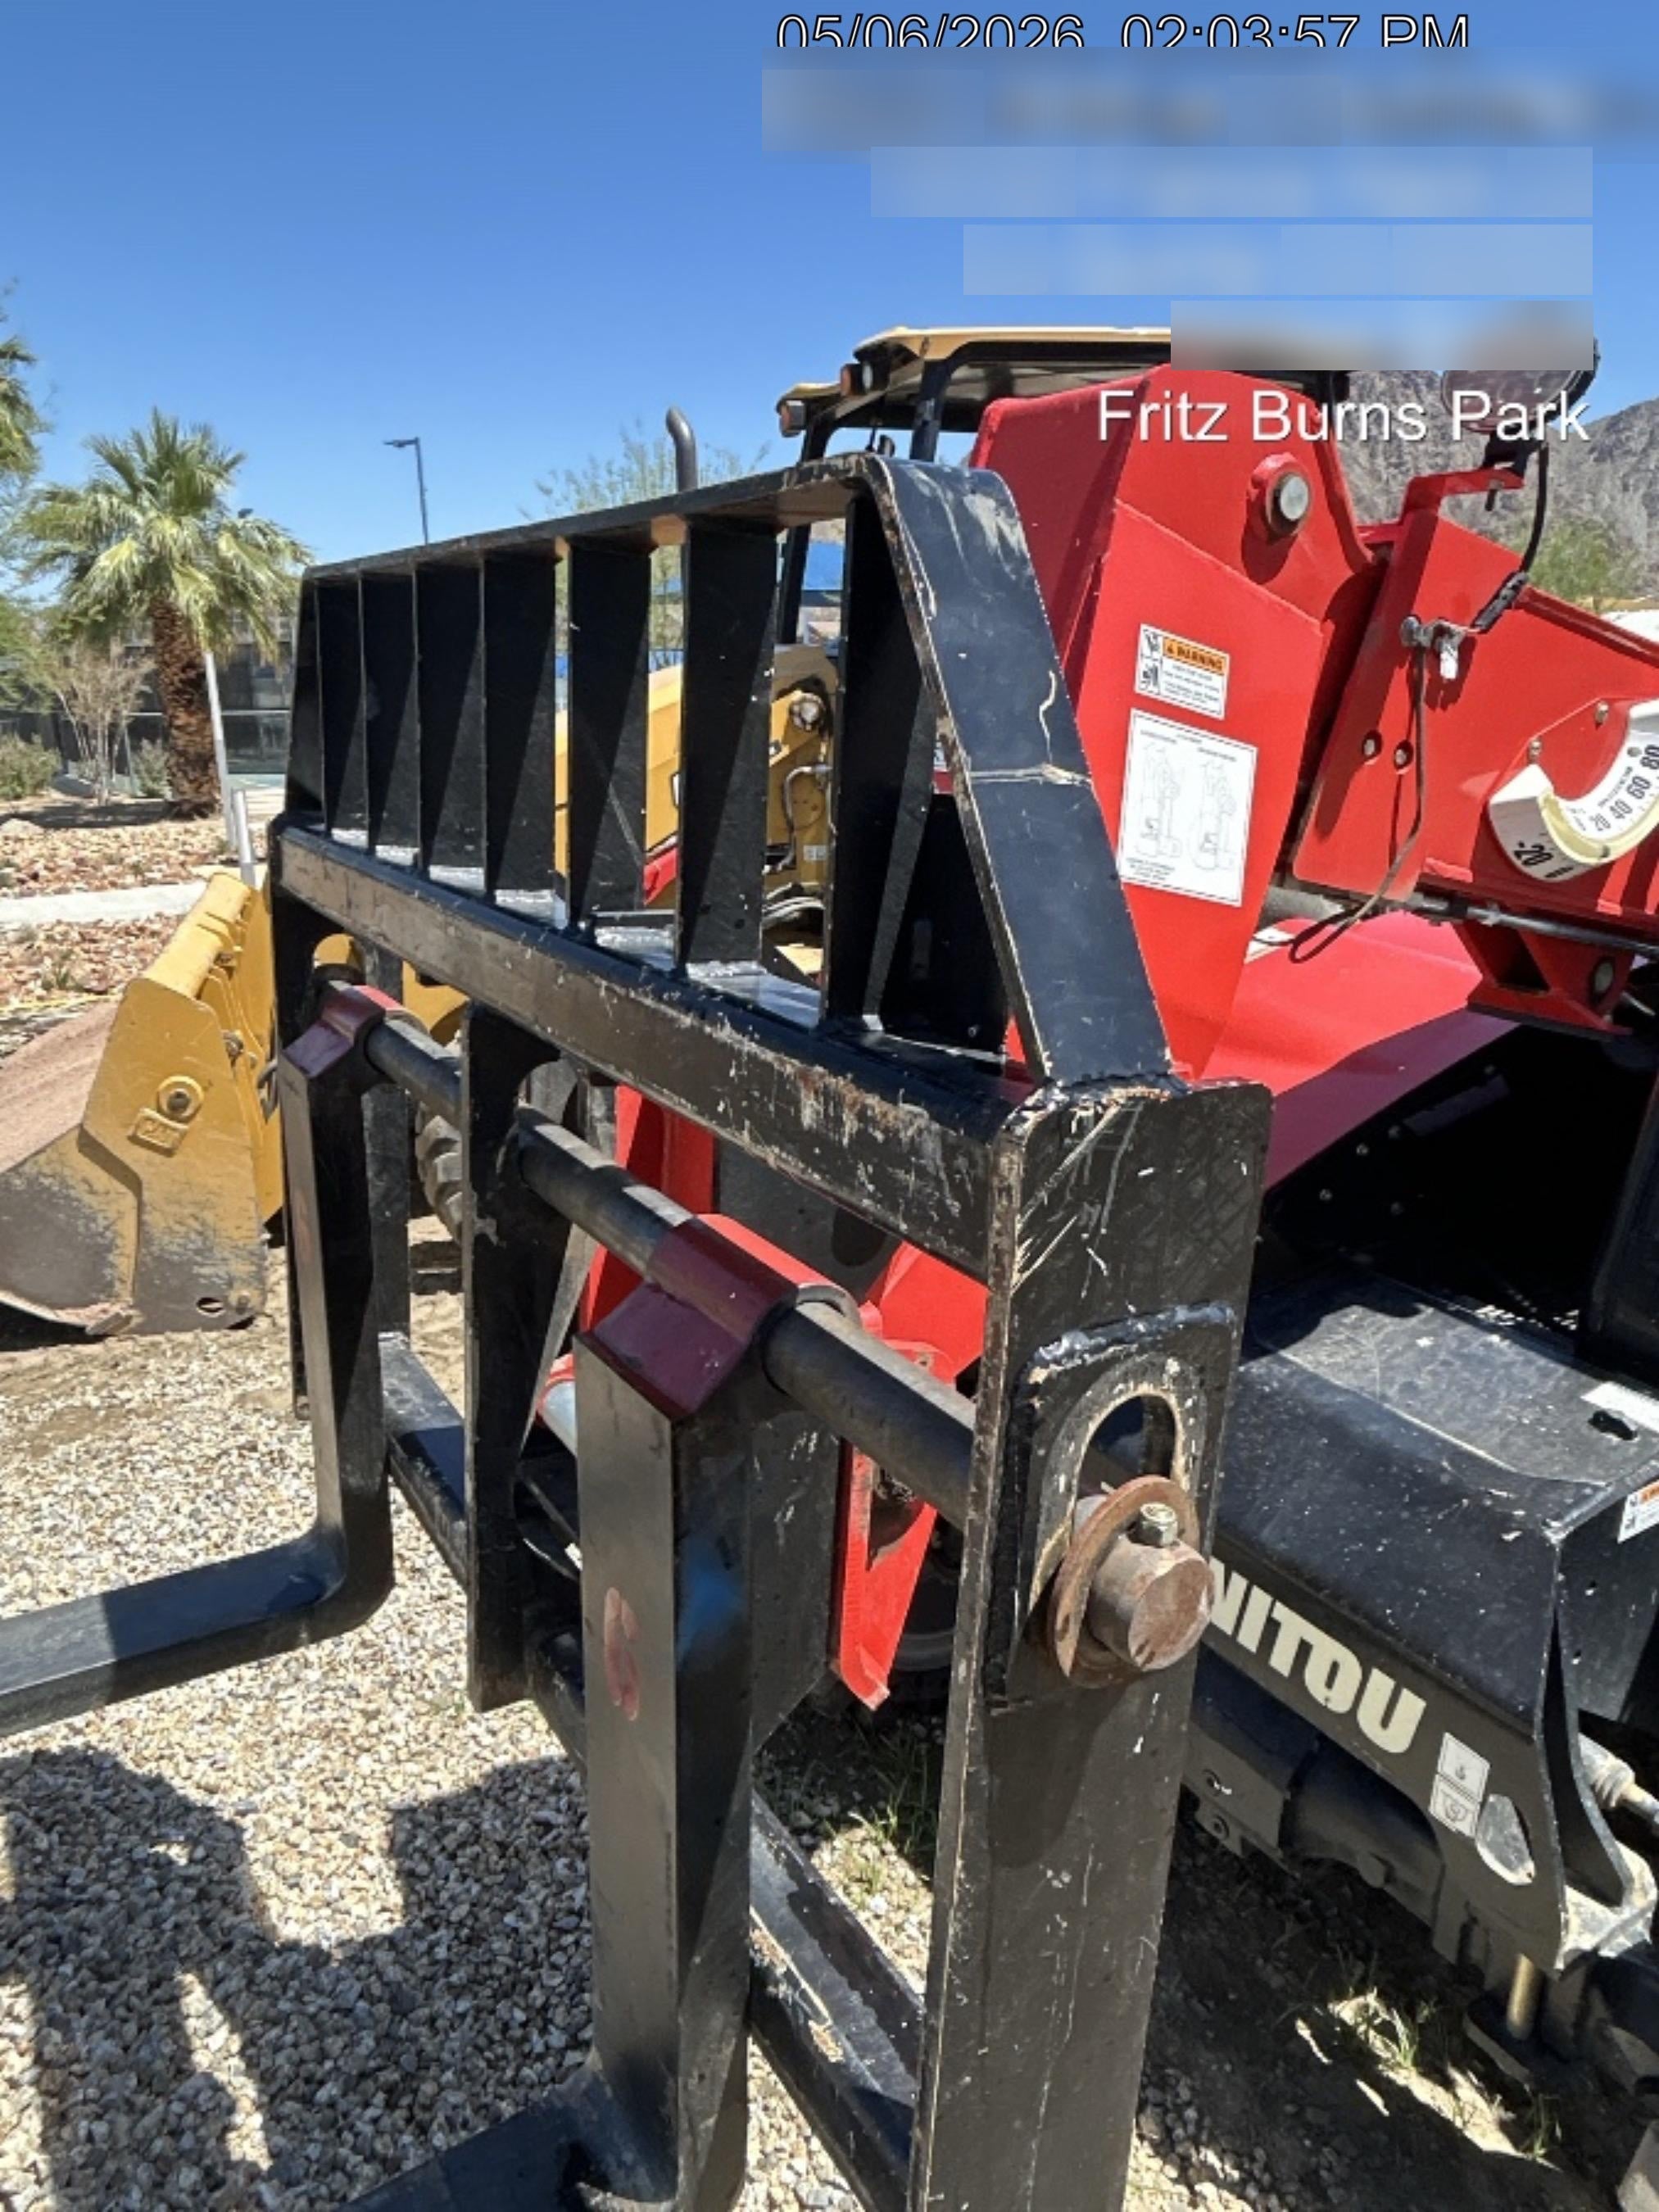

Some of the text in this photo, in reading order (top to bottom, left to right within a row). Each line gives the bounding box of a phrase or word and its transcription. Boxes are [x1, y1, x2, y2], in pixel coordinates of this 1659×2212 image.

[1177, 645, 1223, 672] WARNING
[1627, 775, 1652, 800] 60
[1609, 799, 1633, 819] 40
[1589, 814, 1611, 832] 20
[1208, 1555, 1426, 1753] NITOU
